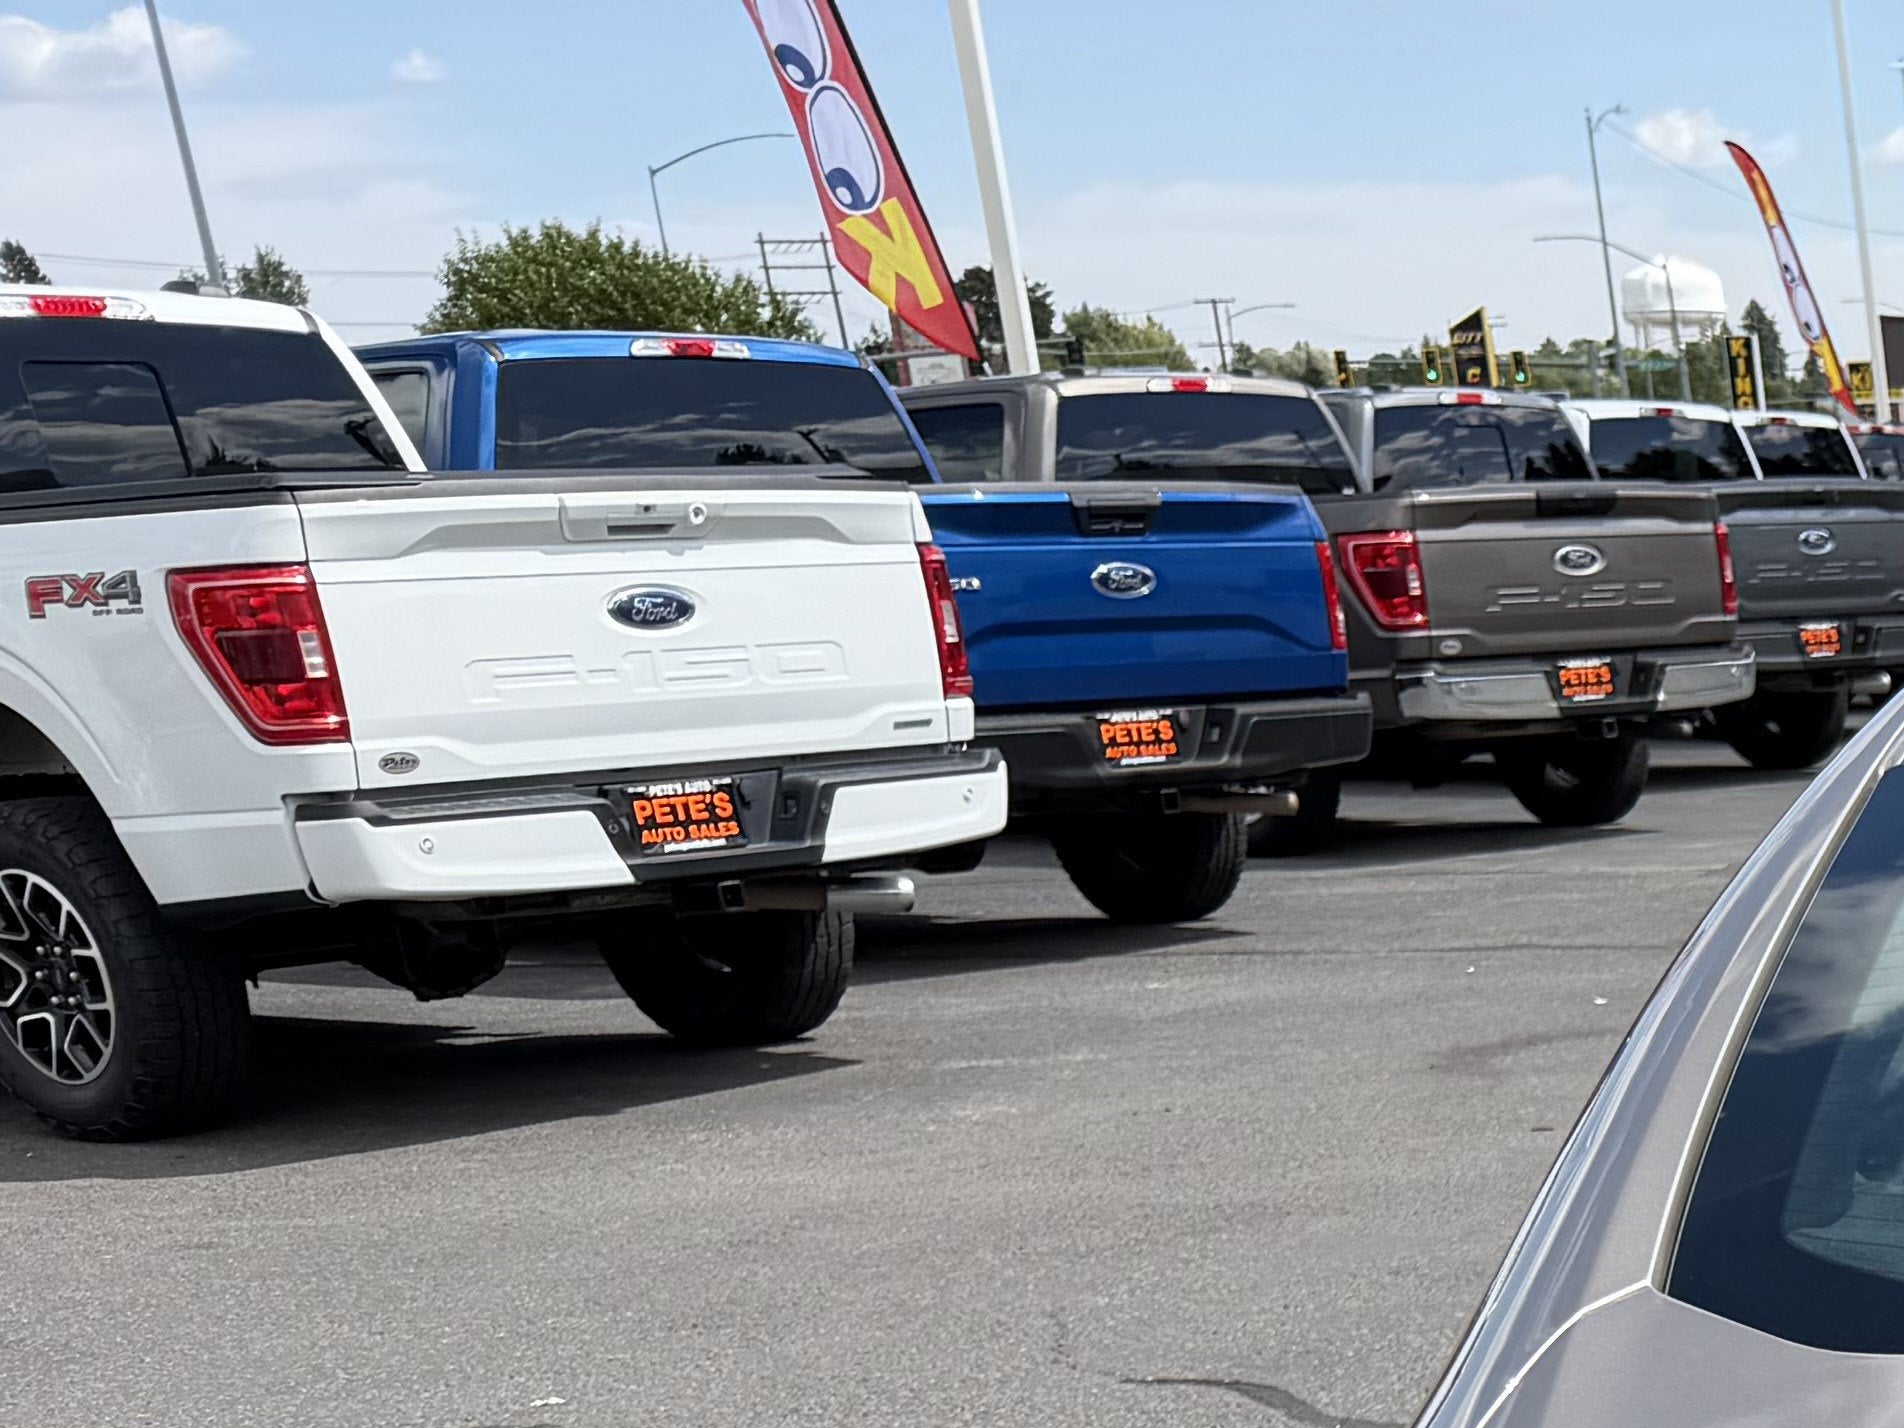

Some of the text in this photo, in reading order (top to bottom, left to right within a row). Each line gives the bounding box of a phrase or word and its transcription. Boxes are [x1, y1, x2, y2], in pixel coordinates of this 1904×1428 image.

[24, 569, 142, 619] FX4
[630, 596, 678, 623] Ford
[463, 640, 850, 703] F-150
[1100, 720, 1174, 744] PETE'S
[633, 791, 734, 826] PETE'S
[641, 821, 740, 845] AUTO SALES
